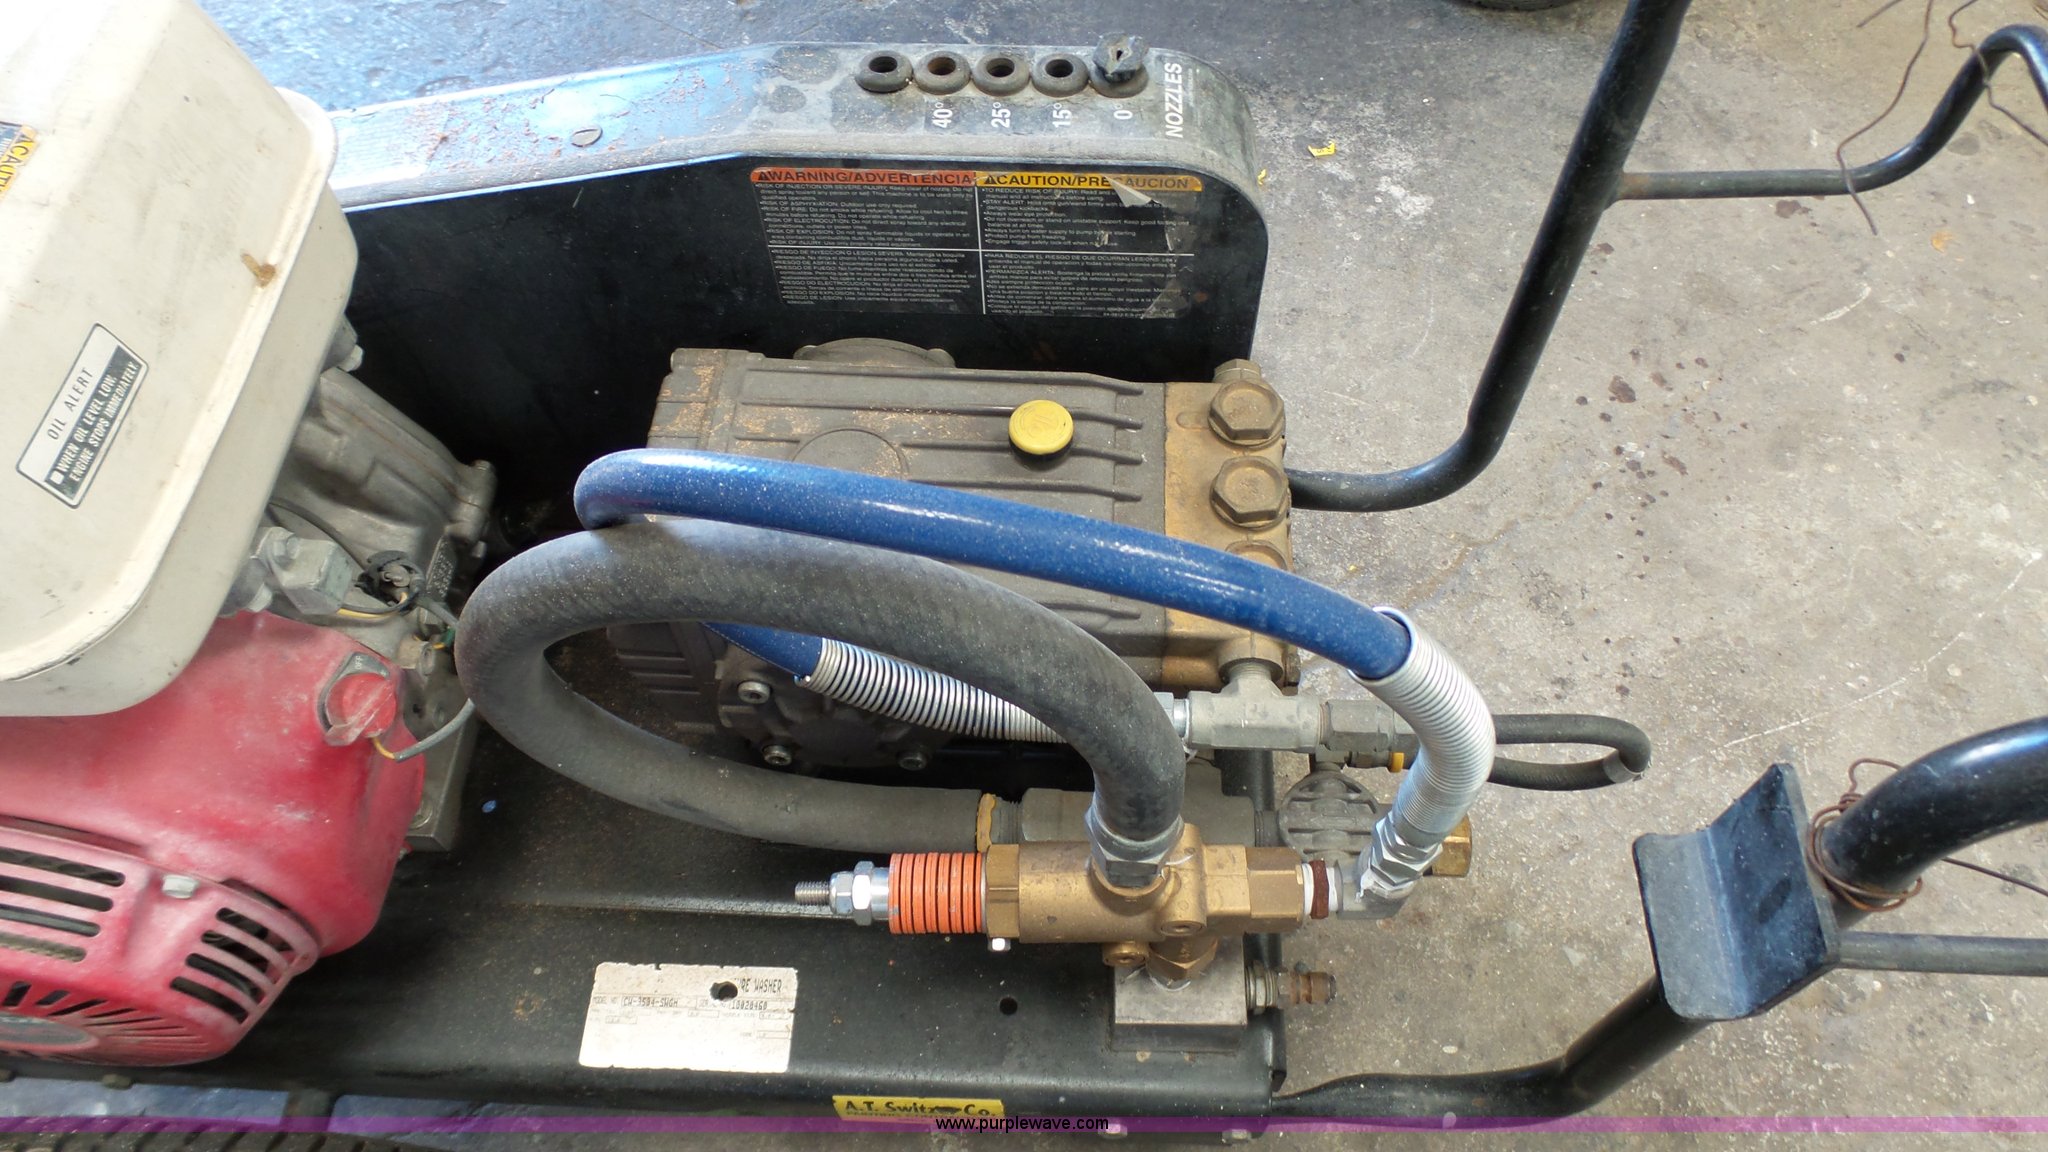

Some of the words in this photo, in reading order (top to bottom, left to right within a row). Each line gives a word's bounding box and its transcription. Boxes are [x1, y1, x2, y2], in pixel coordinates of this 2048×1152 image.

[1164, 62, 1184, 139] NOZZLES
[0, 145, 29, 189] CAUT
[47, 418, 67, 440] OIL
[64, 367, 94, 413] ALERT
[56, 442, 80, 473] WHEN
[73, 427, 89, 443] OIL
[82, 398, 105, 426] LEVEL
[69, 447, 95, 482] ENGINE
[88, 417, 110, 447] STOPS
[355, 655, 364, 670] OFF
[753, 979, 782, 994] WASHER
